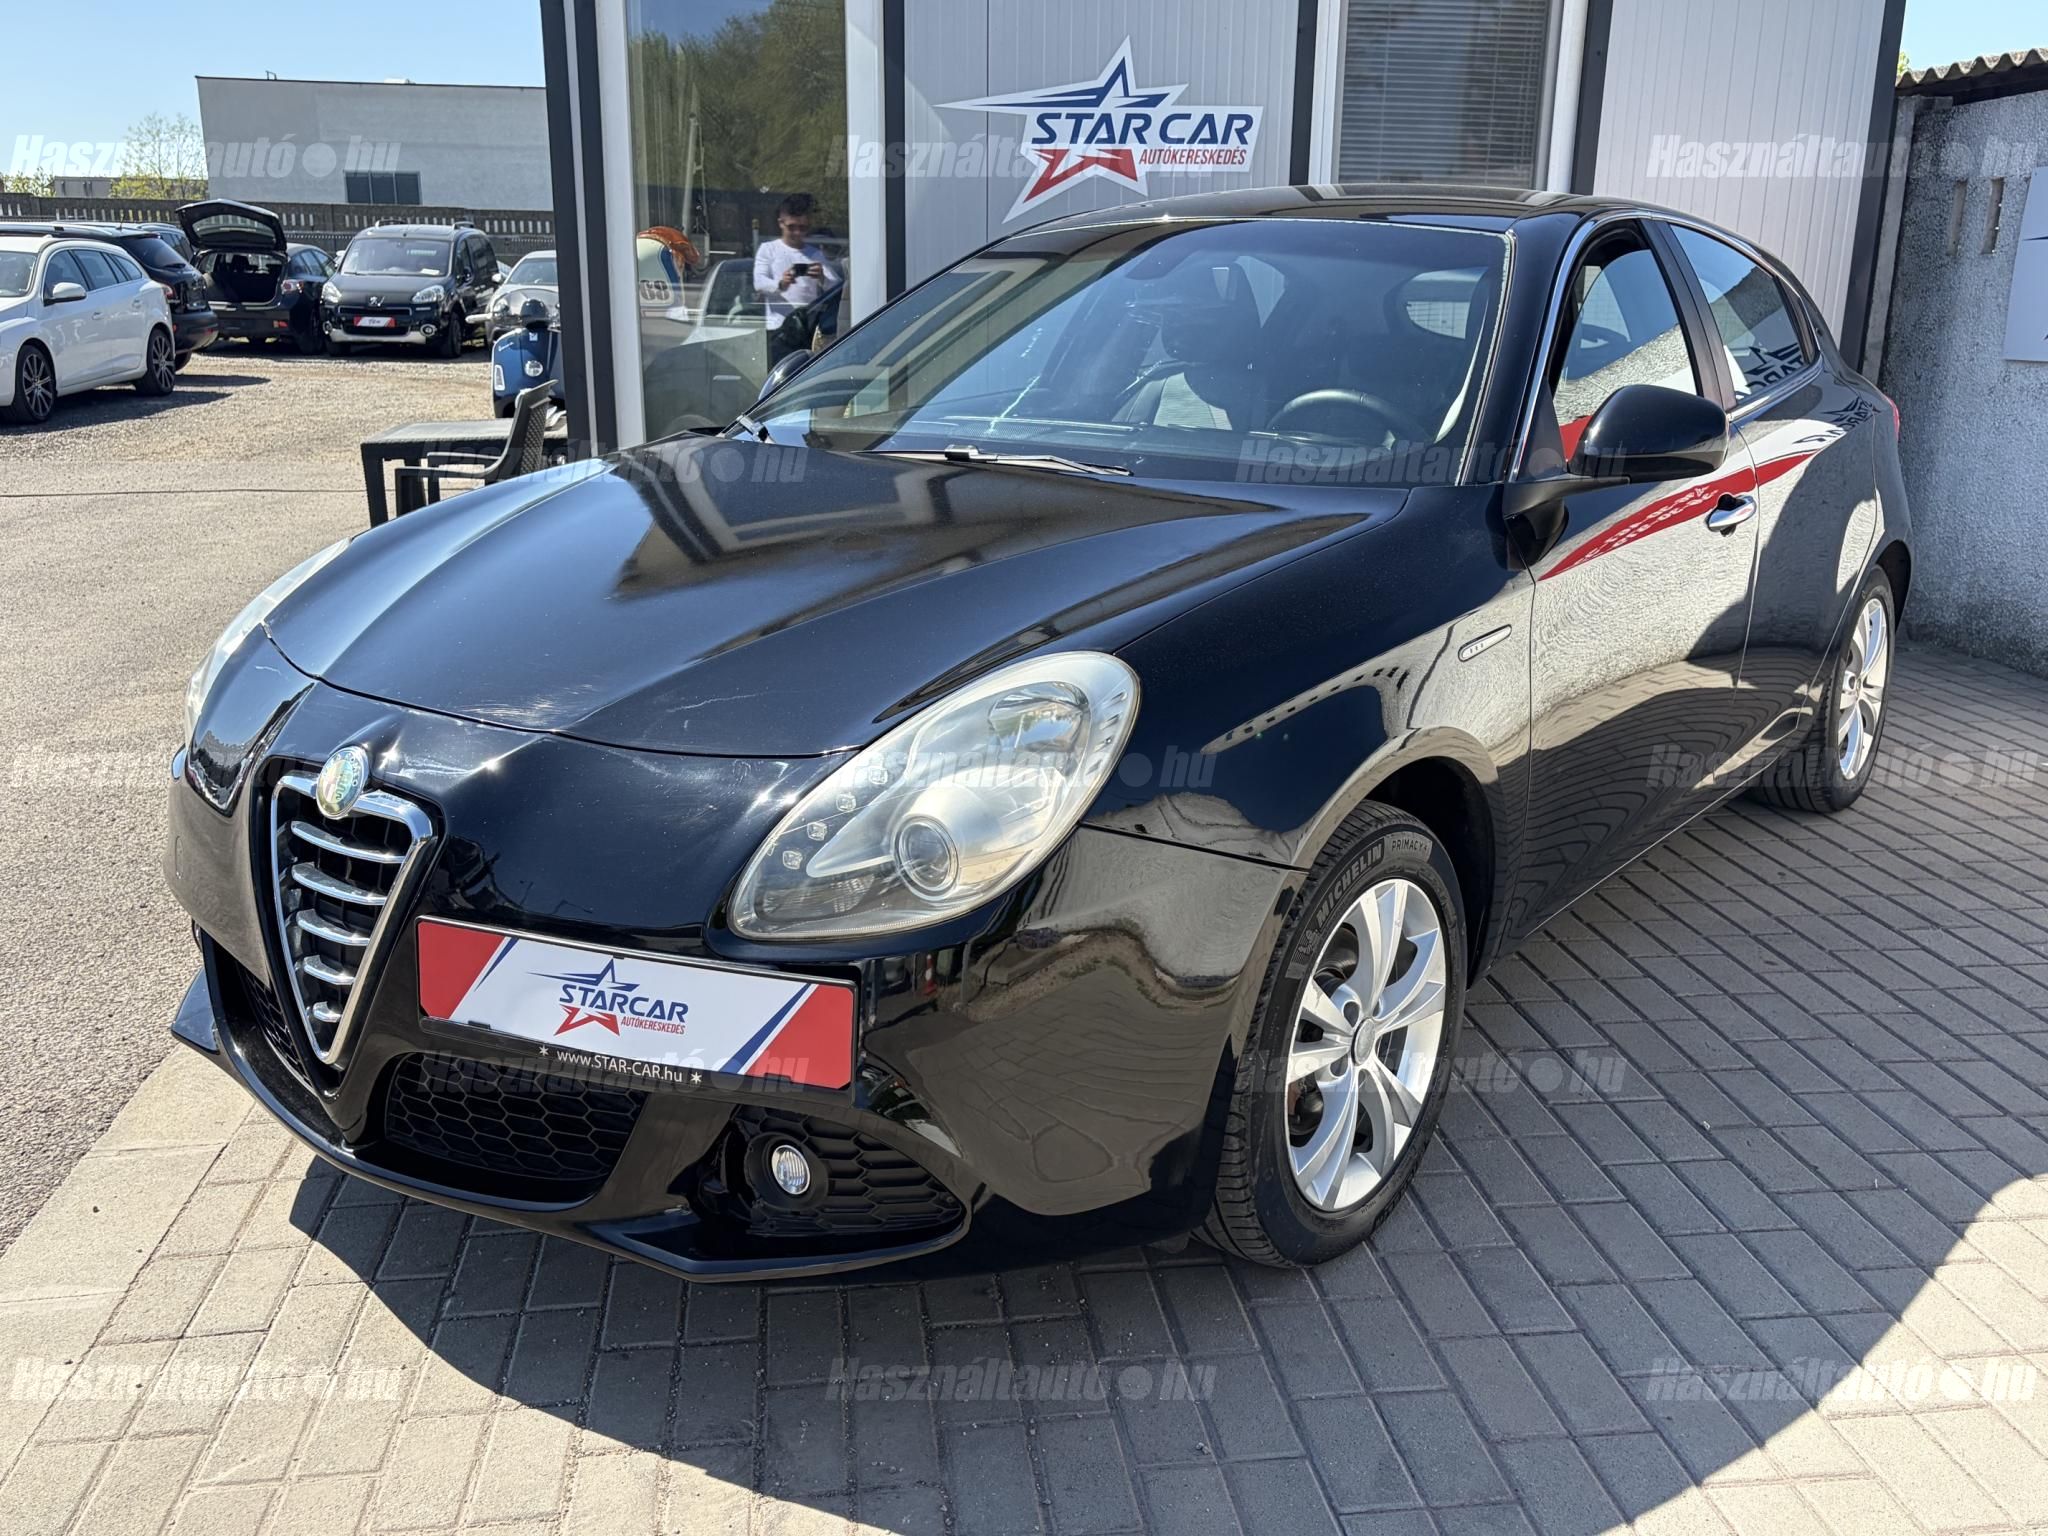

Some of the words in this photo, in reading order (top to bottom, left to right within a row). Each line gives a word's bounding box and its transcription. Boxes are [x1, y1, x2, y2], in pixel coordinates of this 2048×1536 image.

[1139, 146, 1247, 165] AUTÓKERESKEDÉS
[1392, 839, 1423, 851] PRIMACY
[1316, 843, 1384, 927] MICHELIN
[621, 1016, 686, 1035] AUTÓKERESKEDÉS
[556, 1050, 683, 1083] www.STAR-CAR.hu
